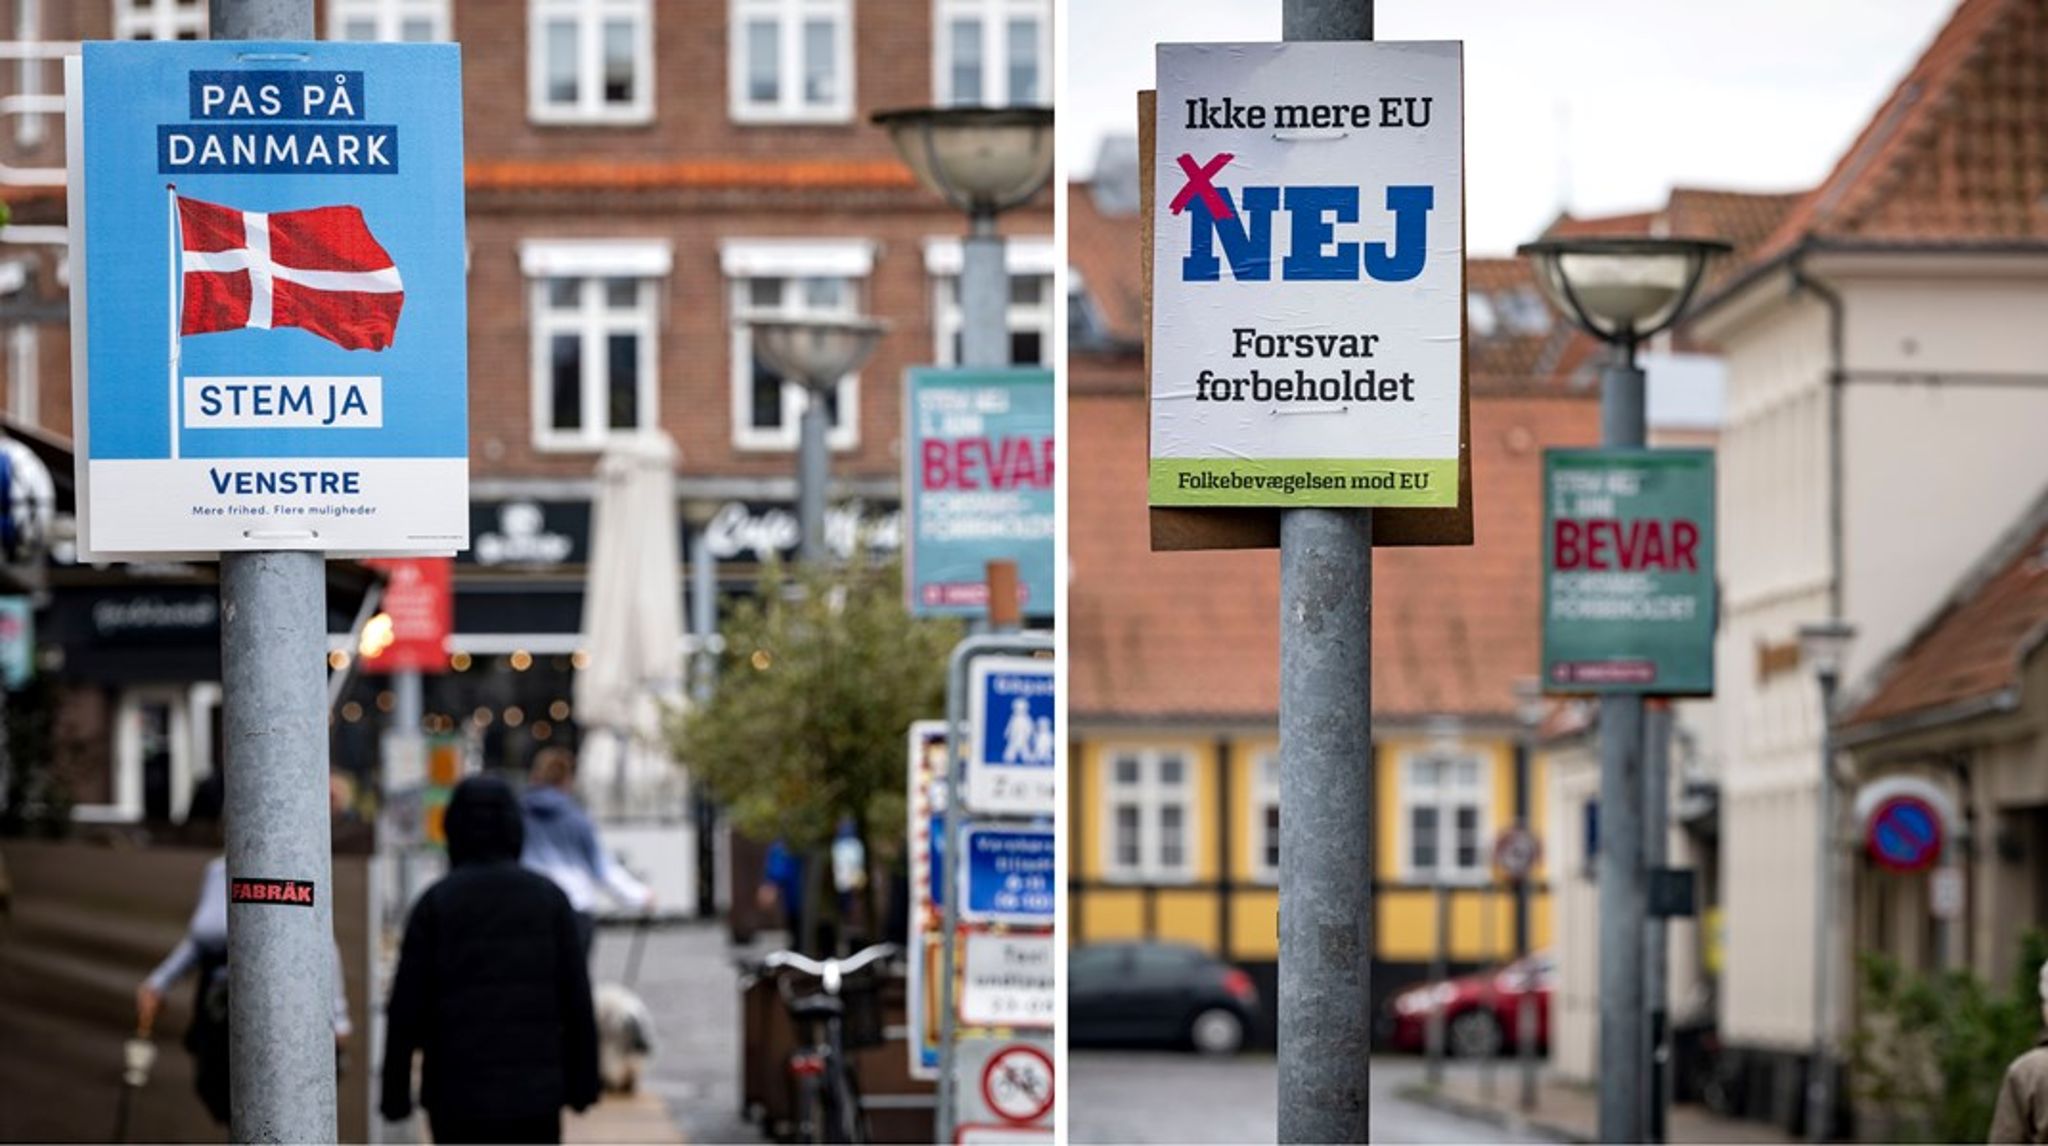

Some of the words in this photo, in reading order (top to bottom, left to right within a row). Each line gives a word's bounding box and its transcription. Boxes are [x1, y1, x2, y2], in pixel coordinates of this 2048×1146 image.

[202, 85, 281, 116] PAS
[303, 74, 355, 116] PÅ
[1185, 97, 1266, 129] Ikke
[1273, 104, 1370, 128] mere
[1379, 97, 1432, 128] EU
[169, 135, 390, 165] DANMARK
[1182, 185, 1434, 281] NEJ
[1232, 328, 1379, 358] Forsvar
[1195, 369, 1415, 402] forbeholdet
[200, 385, 314, 416] STEM
[322, 385, 368, 425] JA
[210, 467, 360, 494] VENSTRE
[1178, 472, 1346, 493] Folkebevægelsen
[1351, 472, 1395, 489] mod
[1400, 473, 1429, 489] EU
[192, 505, 224, 516] Mere
[228, 504, 269, 516] frihed.
[273, 504, 304, 516] Flere
[308, 504, 376, 518] muligheder
[1554, 517, 1699, 573] BEVAR
[232, 881, 312, 902] FABRÄK
